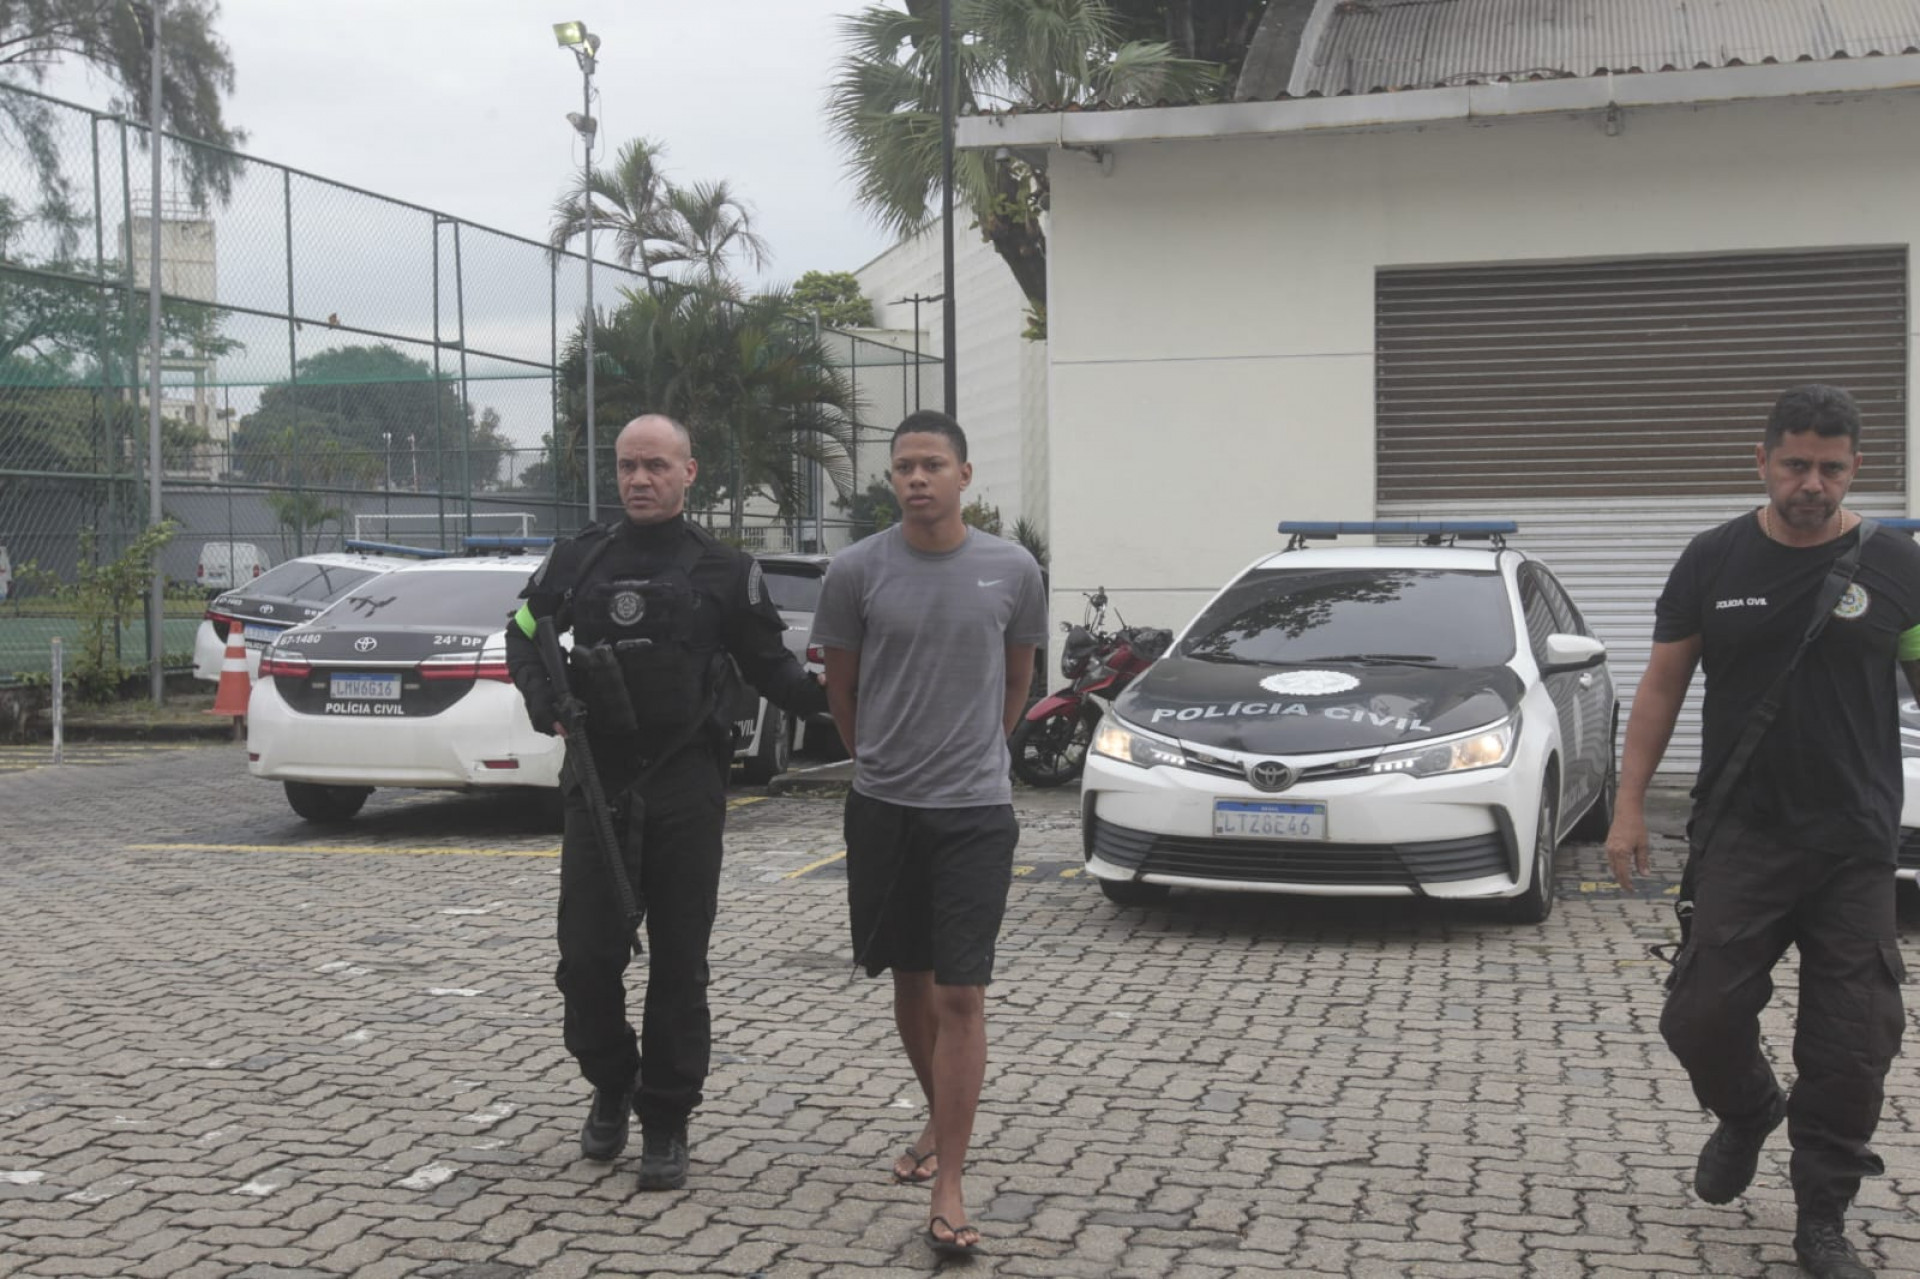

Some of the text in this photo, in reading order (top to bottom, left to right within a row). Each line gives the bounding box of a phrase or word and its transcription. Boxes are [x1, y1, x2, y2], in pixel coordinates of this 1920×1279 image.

[461, 636, 482, 647] DP
[325, 701, 405, 715] POLÍCIA CIVIL
[1151, 701, 1432, 732] POLÍCIA CIVIL
